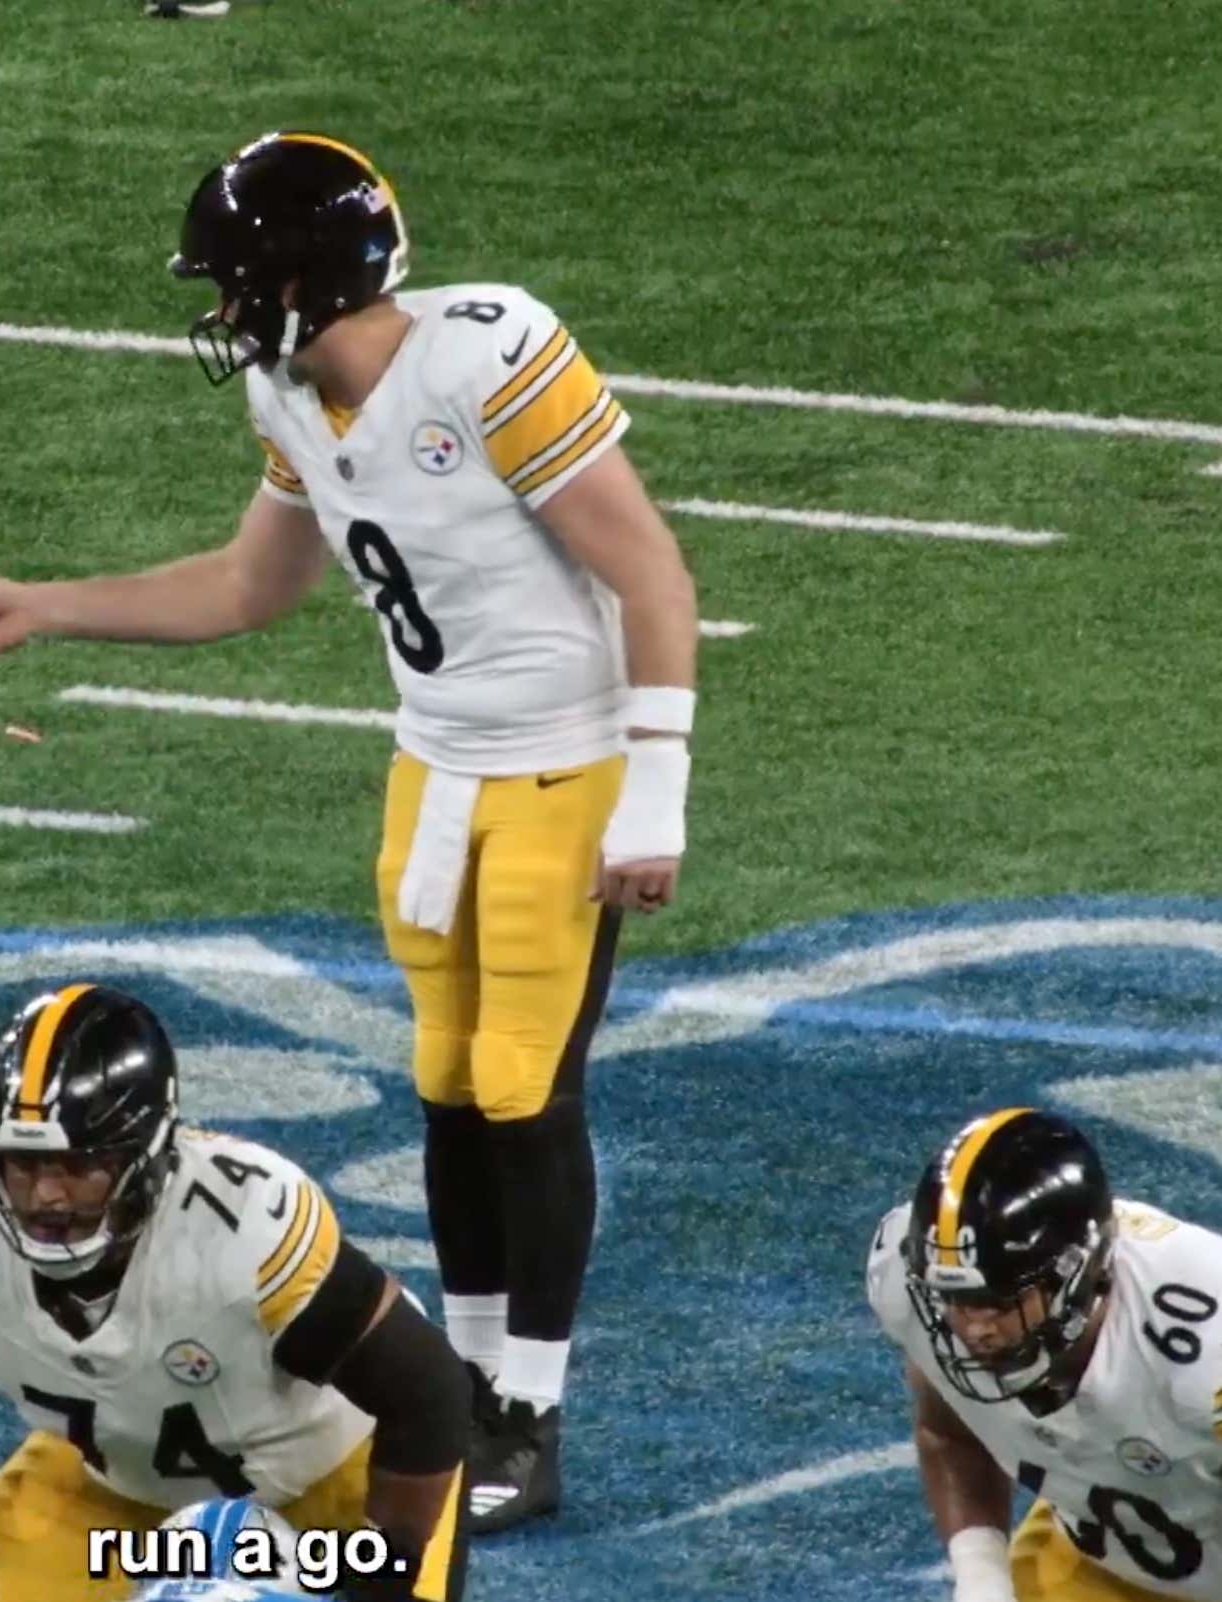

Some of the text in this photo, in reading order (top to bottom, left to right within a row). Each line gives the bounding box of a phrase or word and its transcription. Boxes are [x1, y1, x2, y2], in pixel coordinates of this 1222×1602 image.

[444, 301, 506, 324] 8
[346, 519, 444, 674] 8
[183, 1153, 271, 1232] 74
[1143, 1283, 1218, 1365] 60
[22, 1384, 256, 1498] 74
